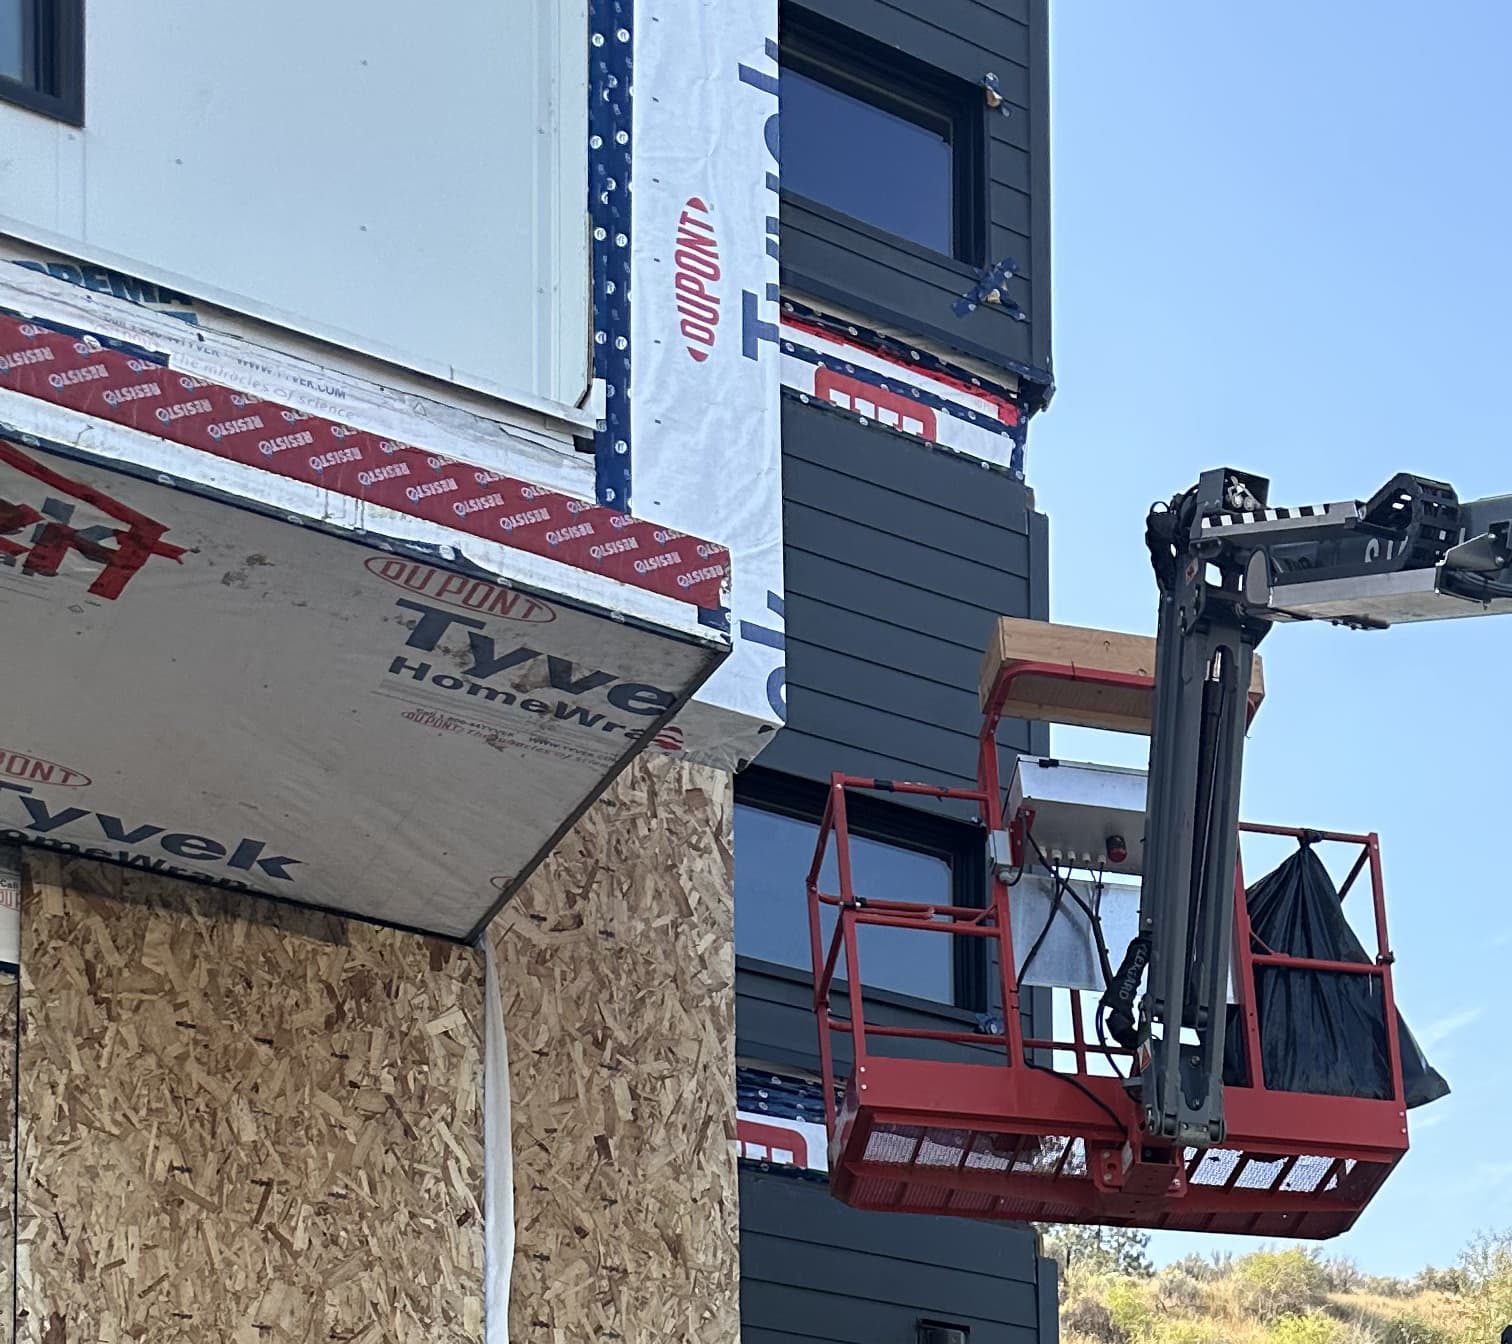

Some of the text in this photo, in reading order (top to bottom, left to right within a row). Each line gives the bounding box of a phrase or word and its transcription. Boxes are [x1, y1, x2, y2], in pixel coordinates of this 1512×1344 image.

[675, 211, 721, 347] DUPONT
[388, 655, 648, 741] HomeWra
[395, 598, 680, 716] Tyve
[0, 781, 306, 882] yvek
